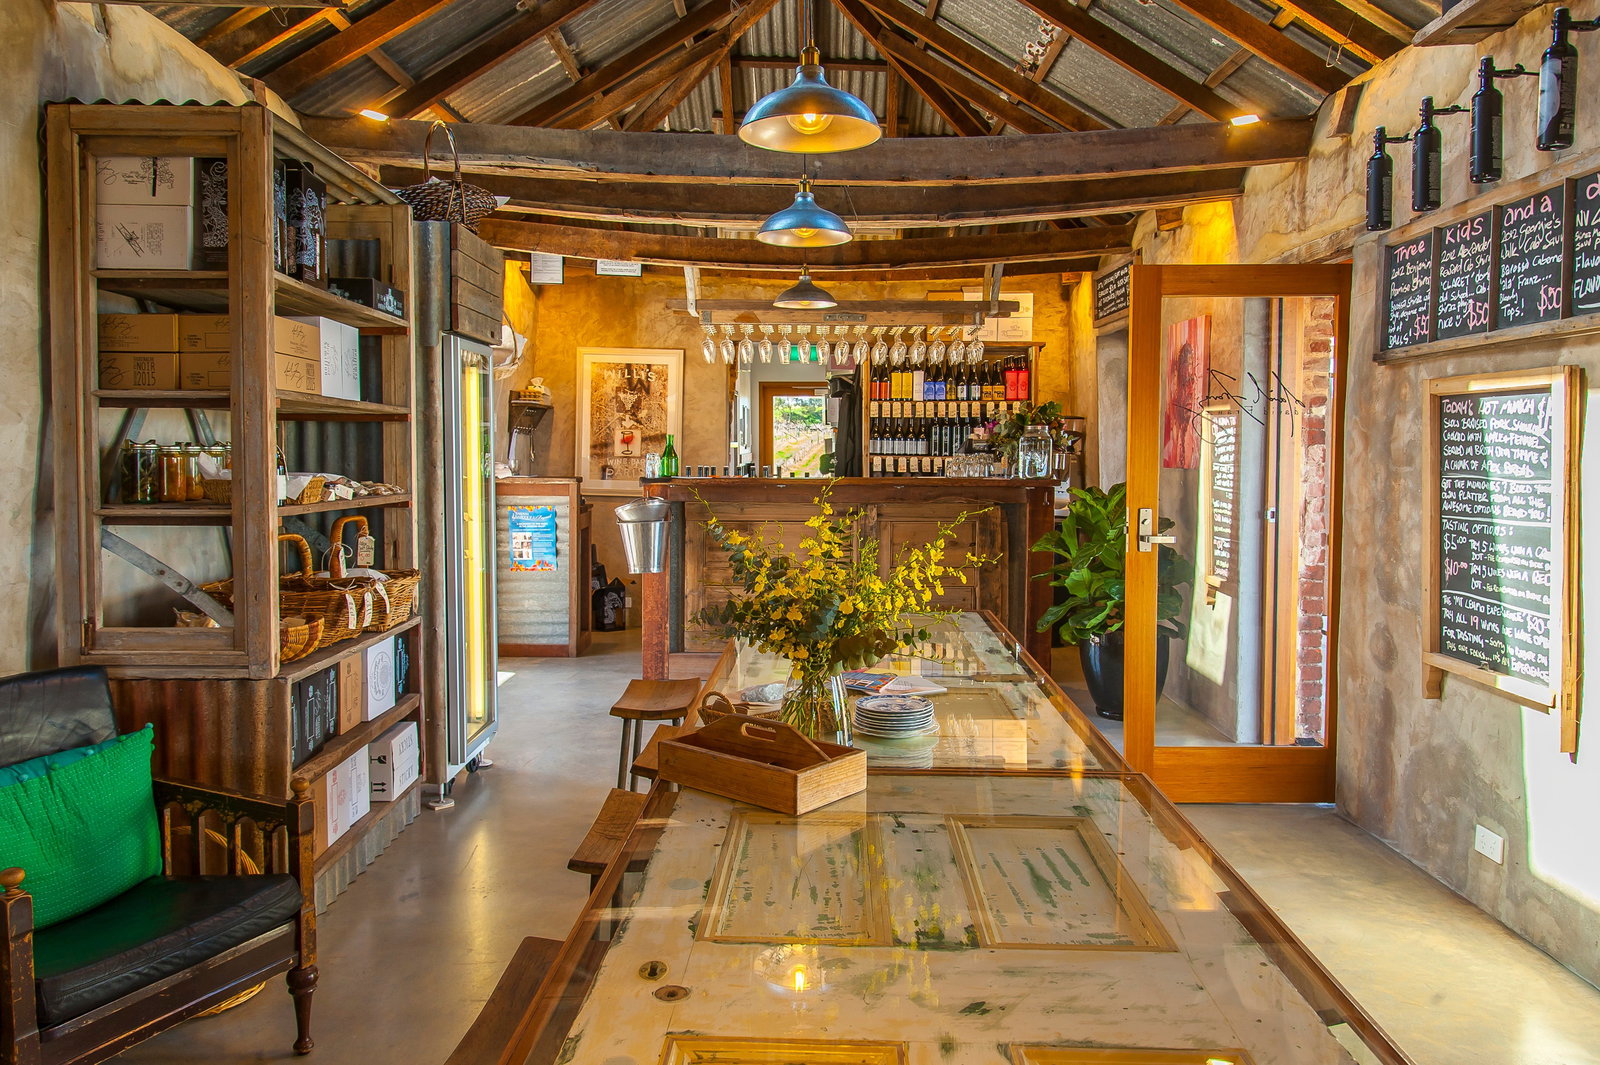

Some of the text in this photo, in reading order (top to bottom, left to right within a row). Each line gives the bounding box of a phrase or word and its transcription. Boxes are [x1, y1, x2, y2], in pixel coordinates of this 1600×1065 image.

[1504, 196, 1552, 226] and a
[1446, 218, 1484, 244] Kids
[1394, 240, 1426, 263] Three
[1532, 254, 1562, 267] Caberne
[1576, 252, 1600, 272] Flavo
[1574, 275, 1600, 299] FLAVO
